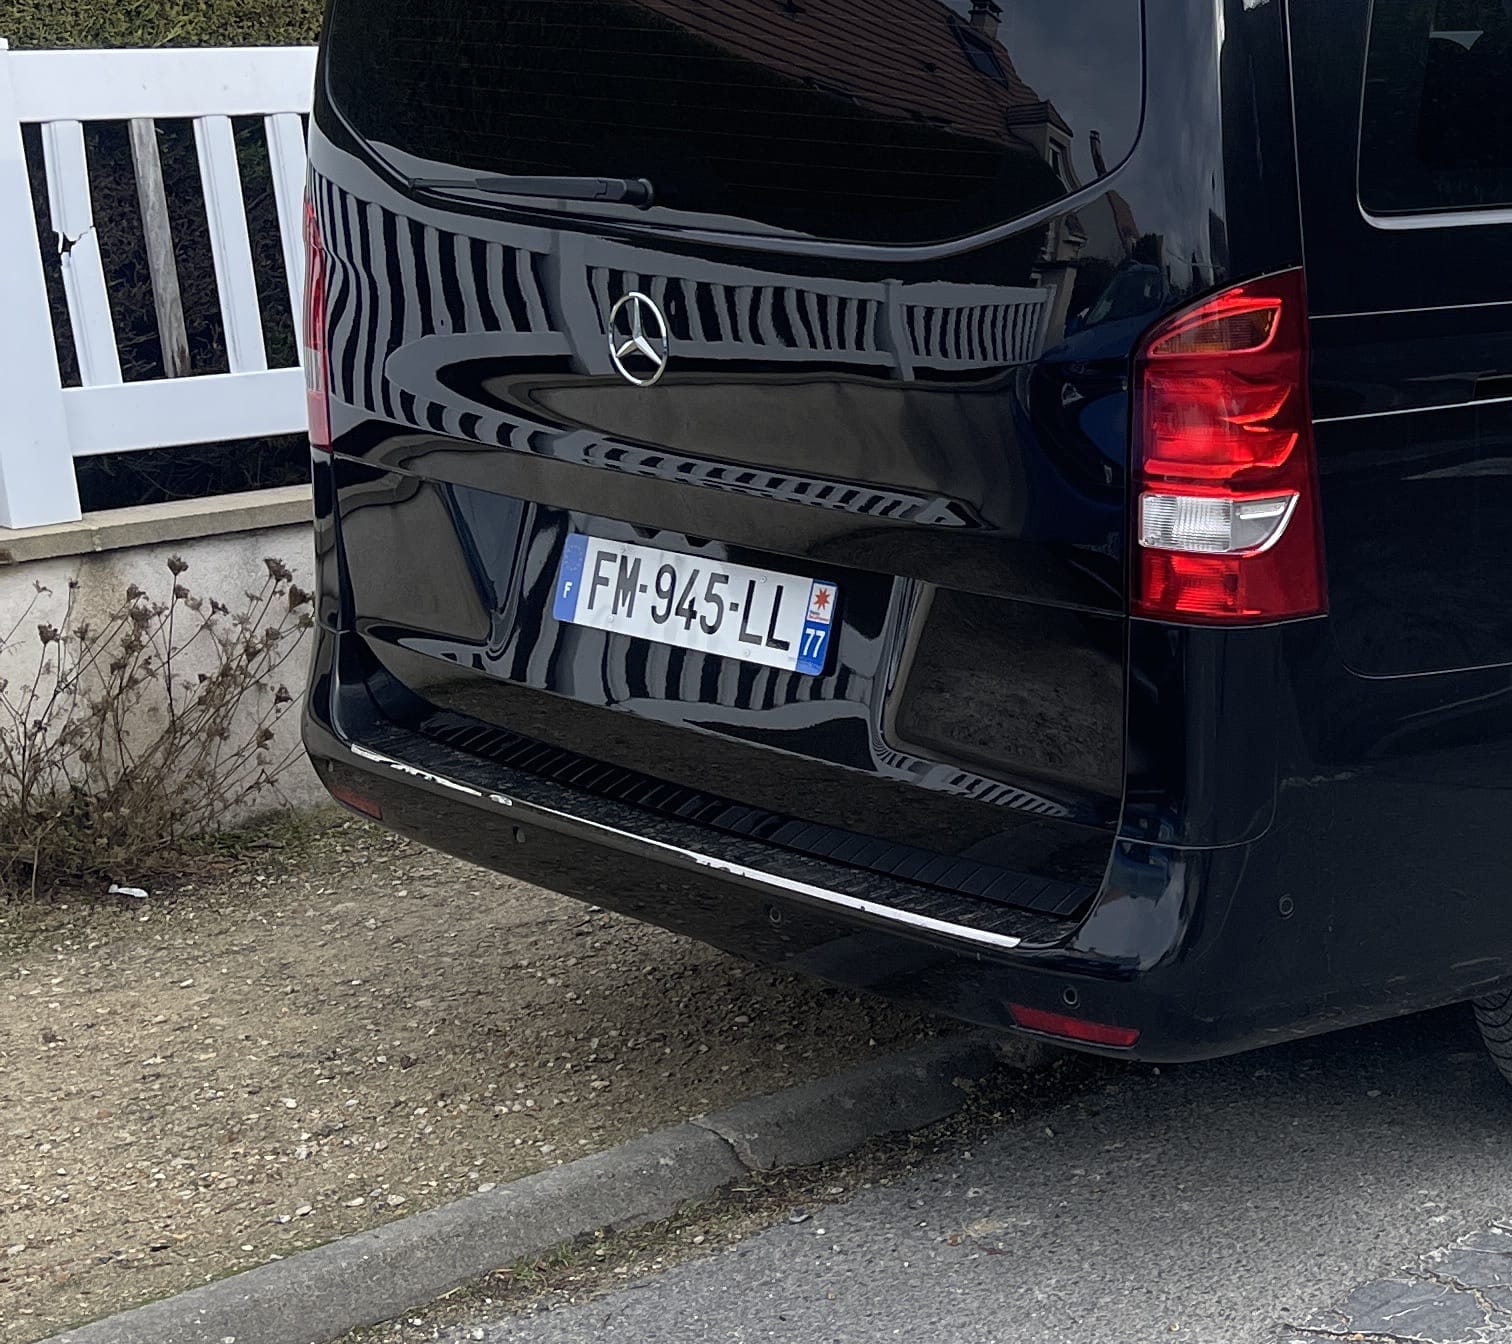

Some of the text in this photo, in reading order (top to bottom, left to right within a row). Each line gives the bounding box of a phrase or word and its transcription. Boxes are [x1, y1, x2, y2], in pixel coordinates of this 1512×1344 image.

[562, 581, 573, 599] F
[587, 550, 790, 651] FM-945-LL
[803, 627, 826, 658] 77
